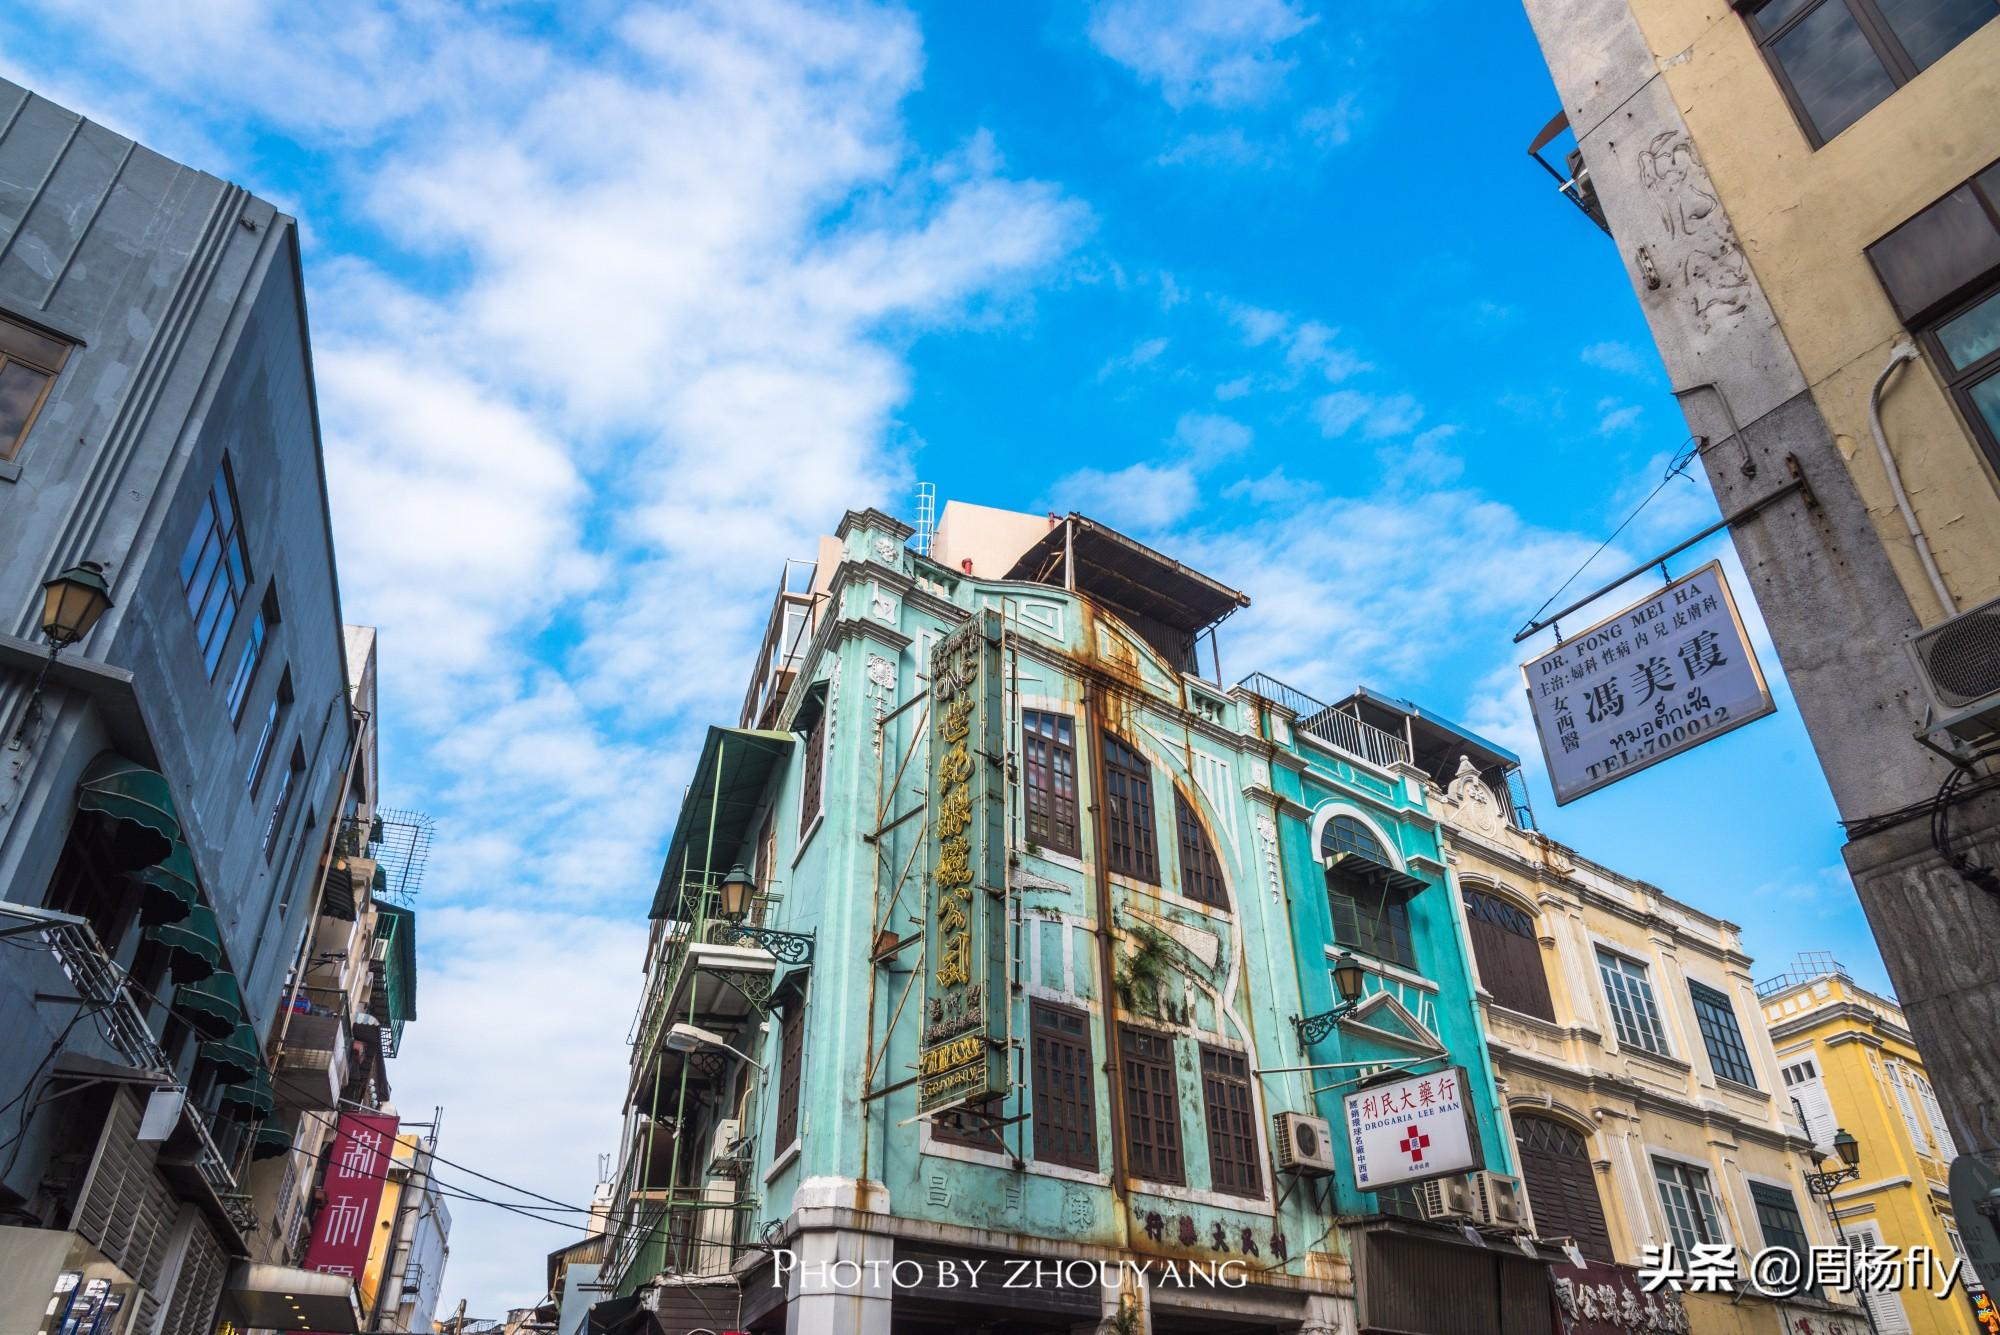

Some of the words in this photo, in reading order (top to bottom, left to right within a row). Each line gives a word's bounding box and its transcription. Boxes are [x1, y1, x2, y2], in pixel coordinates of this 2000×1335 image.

[1541, 655, 1569, 675] DR.
[1576, 624, 1622, 657] FONG
[1630, 600, 1667, 628] MEI
[1673, 583, 1702, 605] HA
[1583, 630, 1728, 723] 馮美霞
[1551, 696, 1580, 754] 女西醫
[1362, 1078, 1455, 1119] 利民大藥行
[1365, 1114, 1413, 1131] DROGARIA
[1418, 1108, 1435, 1119] LEE
[1439, 1102, 1460, 1114] MAN
